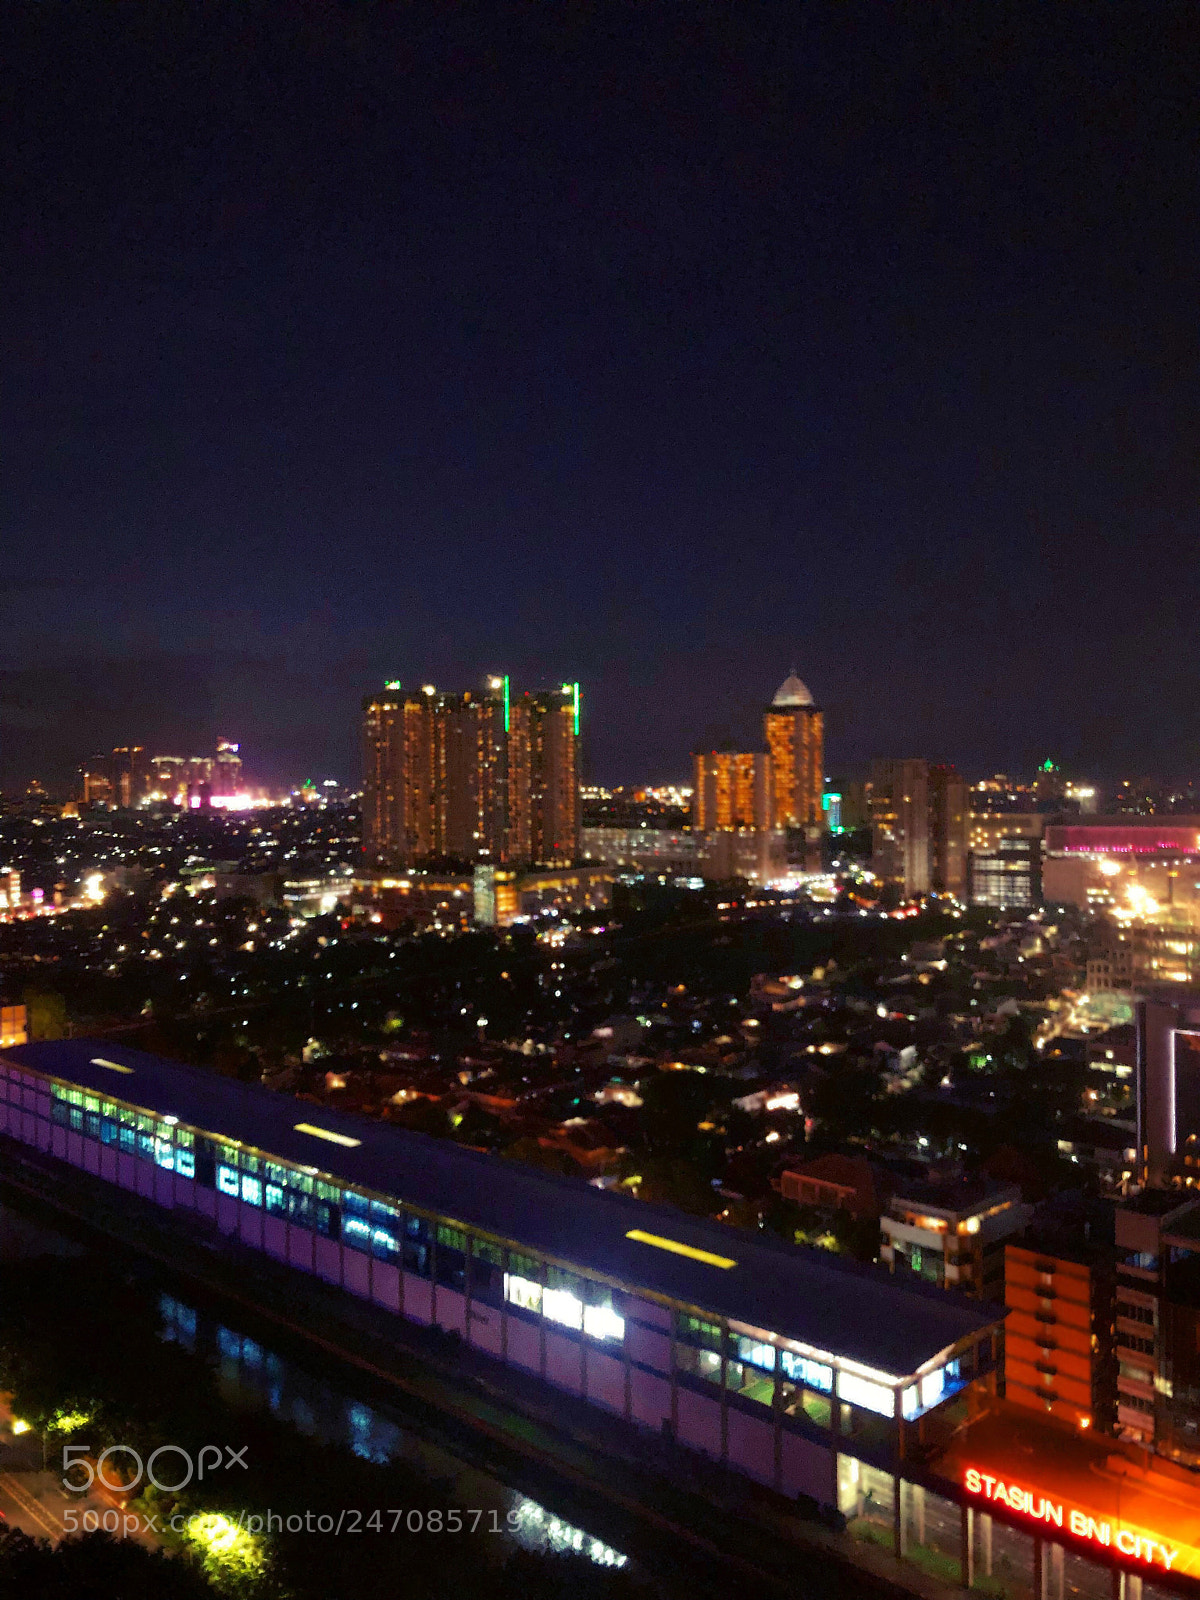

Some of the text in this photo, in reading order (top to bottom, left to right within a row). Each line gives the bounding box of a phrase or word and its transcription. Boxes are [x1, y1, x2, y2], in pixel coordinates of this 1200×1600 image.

[965, 1469, 1179, 1570] STASIUN BNI CITY
